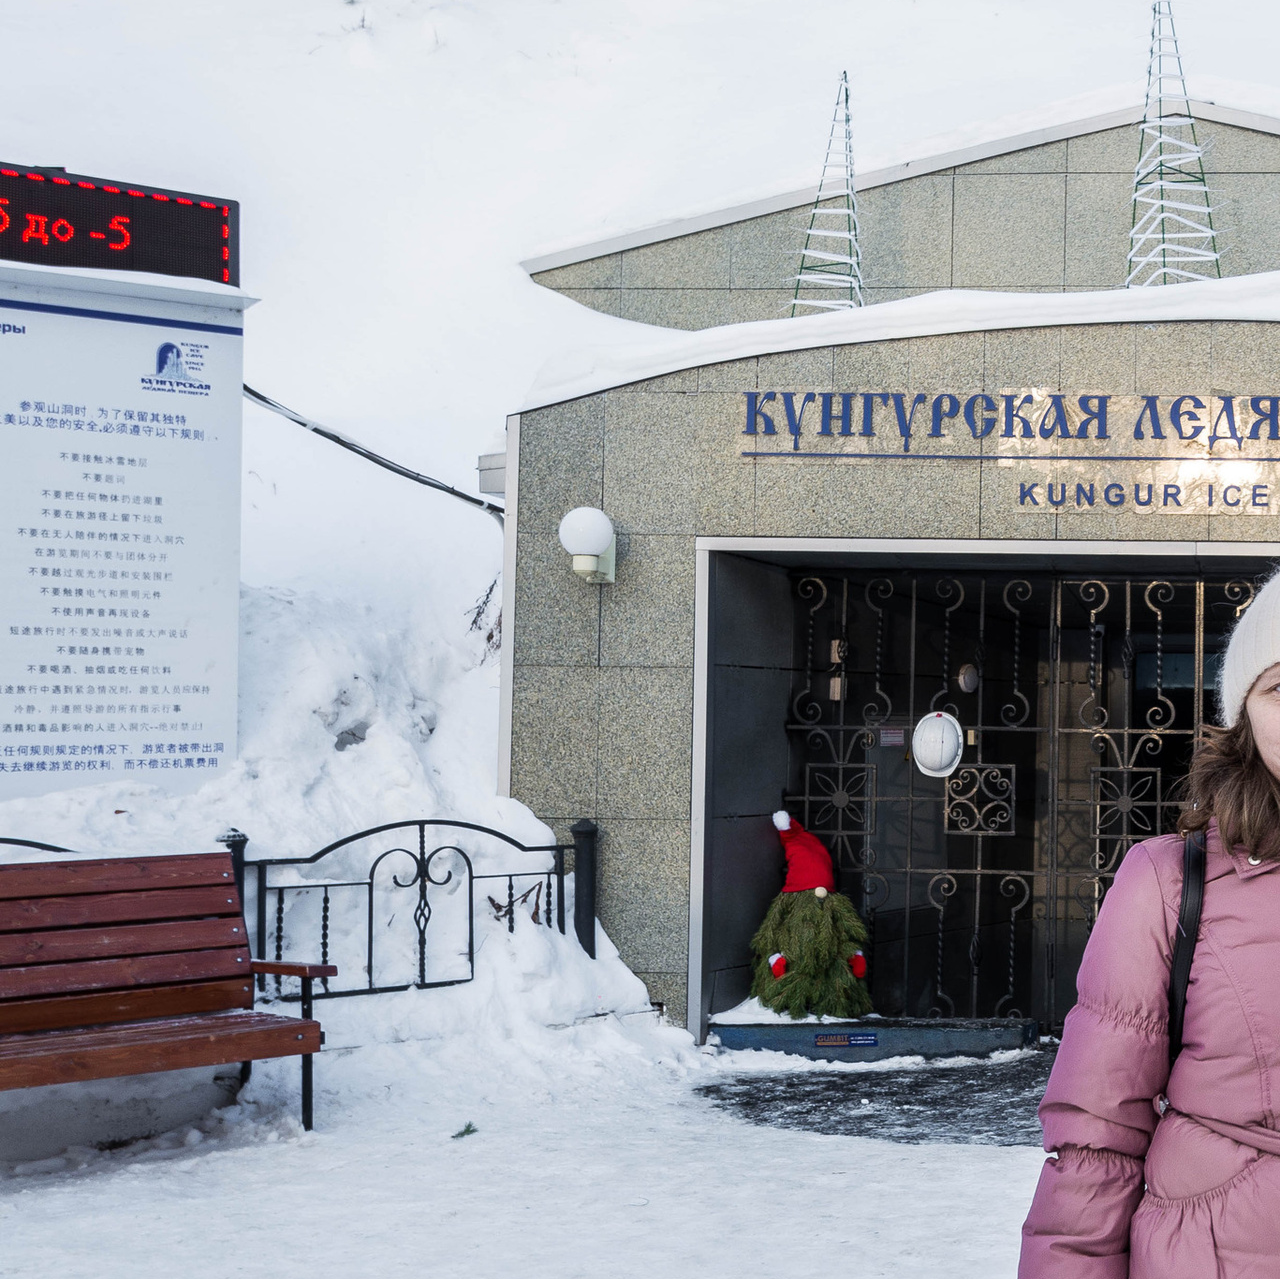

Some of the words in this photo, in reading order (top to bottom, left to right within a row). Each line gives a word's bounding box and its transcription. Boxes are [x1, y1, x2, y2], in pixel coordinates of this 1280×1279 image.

[22, 213, 75, 246] до
[89, 215, 131, 250] -5
[742, 391, 1110, 453] КУНГУРСКАЯ
[1019, 482, 1182, 506] KUNGUR
[1208, 485, 1269, 507] ICE
